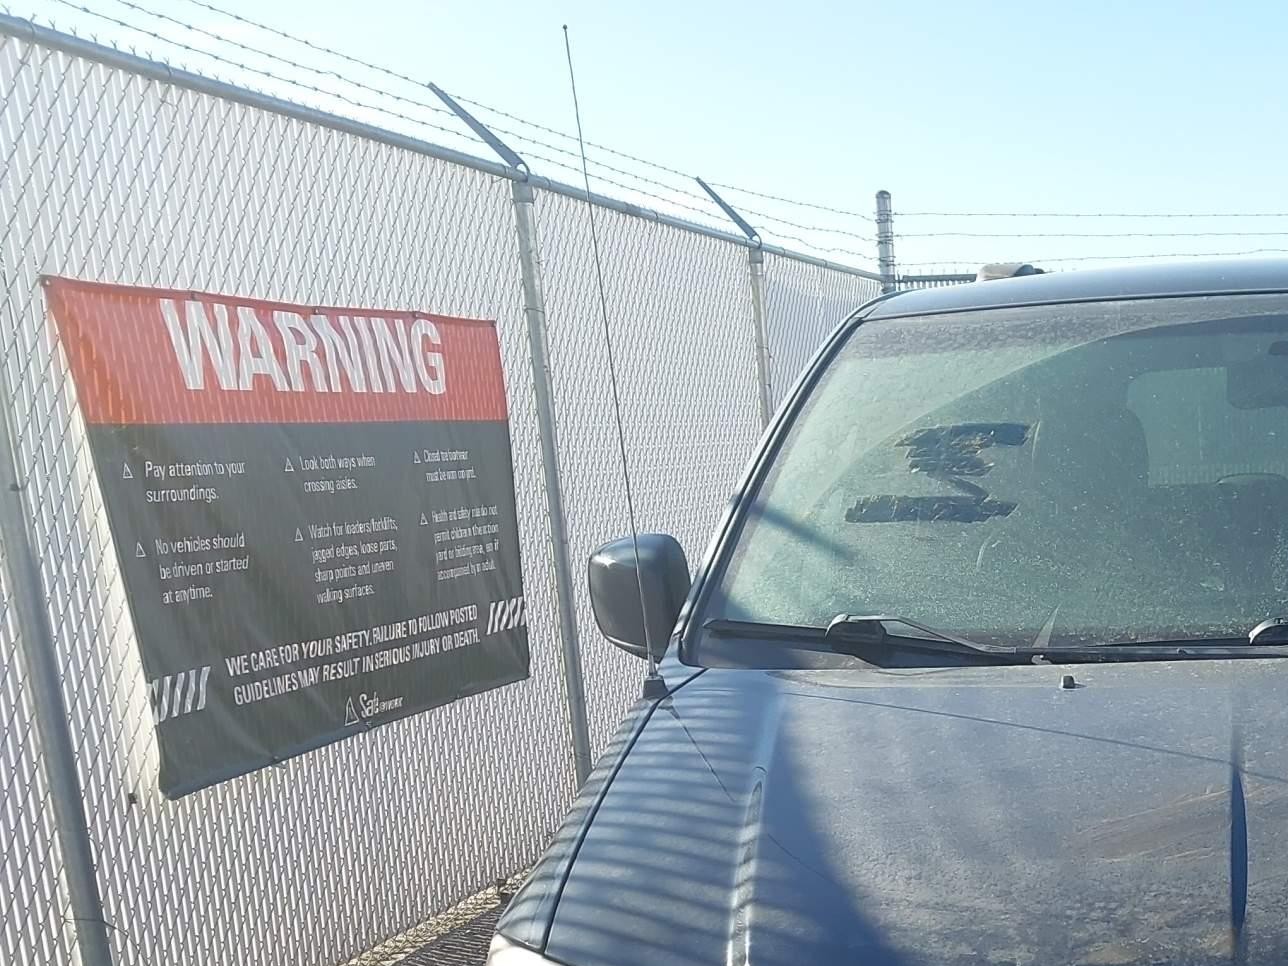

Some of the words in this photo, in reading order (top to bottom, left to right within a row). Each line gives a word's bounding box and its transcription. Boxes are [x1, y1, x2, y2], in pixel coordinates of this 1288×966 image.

[160, 298, 446, 395] WARNING
[145, 461, 165, 480] Pay
[169, 459, 214, 477] attention
[214, 461, 225, 475] to
[225, 461, 246, 478] your
[299, 456, 319, 471] Look
[319, 454, 336, 469] both
[337, 457, 357, 472] ways
[357, 452, 376, 467] when
[146, 485, 219, 503] surroundings.
[304, 476, 335, 493] crossing
[336, 476, 358, 490] aisles.
[308, 522, 332, 539] Watch
[333, 522, 343, 536] for
[155, 539, 169, 555] No
[170, 536, 211, 553] vehicles
[212, 531, 246, 549] should
[311, 544, 334, 564] jagged
[336, 542, 359, 559] edges,
[360, 540, 379, 554] loose
[379, 539, 398, 555] parts,
[159, 563, 172, 579] be
[172, 560, 203, 577] driven
[205, 562, 214, 575] or
[215, 555, 249, 572] started
[315, 568, 334, 583] sharp
[335, 563, 356, 582] points
[357, 561, 370, 576] and
[371, 560, 394, 573] uneven
[163, 590, 174, 604] at
[175, 584, 213, 605] anytime.
[316, 588, 343, 604] walking
[344, 583, 375, 599] surfaces.
[225, 655, 250, 677] WE
[250, 648, 280, 672] CARE
[279, 643, 299, 664] FOR
[301, 638, 333, 659] YOUR
[334, 629, 373, 653] SAFETY.
[372, 621, 407, 644] FAILURE
[408, 618, 418, 636] TO
[418, 610, 449, 633] FOLLOW
[450, 604, 478, 625] POSTED
[233, 672, 299, 705] GUIDELINES
[297, 666, 320, 688] MAY
[322, 657, 360, 682] RESULT
[362, 654, 374, 673] IN
[374, 645, 411, 670] SERIOUS
[411, 637, 441, 660] INJURY
[441, 634, 454, 652] OR
[453, 628, 480, 649] DEATH.
